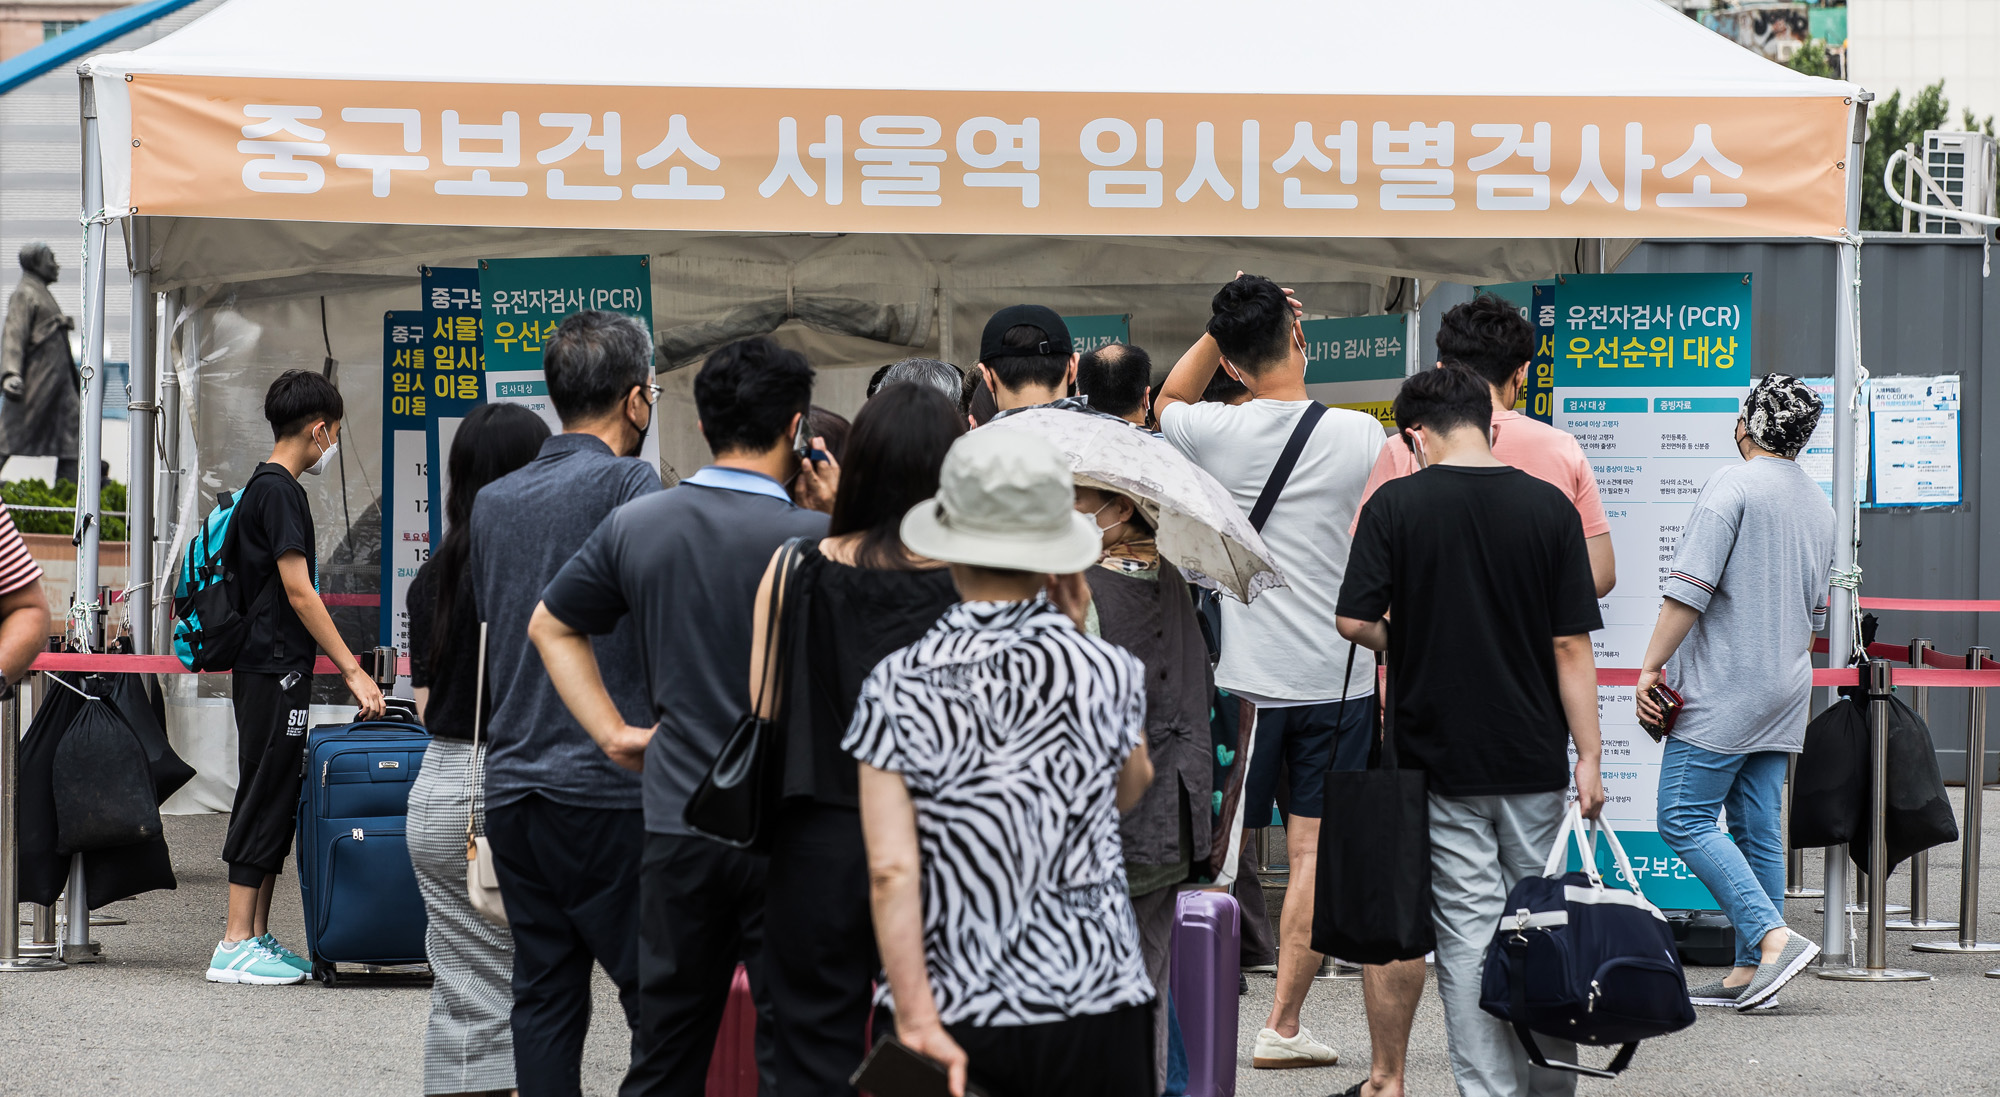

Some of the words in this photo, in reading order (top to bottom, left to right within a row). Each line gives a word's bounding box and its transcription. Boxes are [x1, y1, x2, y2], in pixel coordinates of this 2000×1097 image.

[237, 104, 725, 200] 중구보건소
[758, 114, 1040, 208] 서울역
[1079, 117, 1748, 211] 임시선별검사소
[491, 288, 585, 315] 유전자검사
[590, 286, 642, 312] (PCR)
[432, 316, 484, 341] 서울
[1566, 305, 1673, 330] 유전자검사
[1679, 305, 1740, 330] (PCR)
[433, 345, 486, 371] 임시
[1305, 341, 1341, 361] 나19
[1344, 338, 1372, 360] 검사
[1374, 336, 1401, 358] 접수
[1566, 336, 1674, 369] 우선순위
[1683, 335, 1739, 369] 대상
[434, 374, 479, 399] 이용
[501, 384, 533, 395] 검사대상
[1569, 400, 1606, 411] 검사대상
[1660, 400, 1692, 411] 증빙자료
[1575, 420, 1589, 428] 60세
[1589, 420, 1601, 428] 이상
[1602, 420, 1619, 428] 고령자
[1587, 433, 1598, 441] 이상
[1599, 433, 1614, 441] 고령자
[1623, 465, 1635, 473] 있는
[1636, 465, 1642, 473] 자
[287, 709, 309, 727] SU
[1600, 771, 1619, 779] 별검사
[1612, 856, 1699, 881] 중구보건
